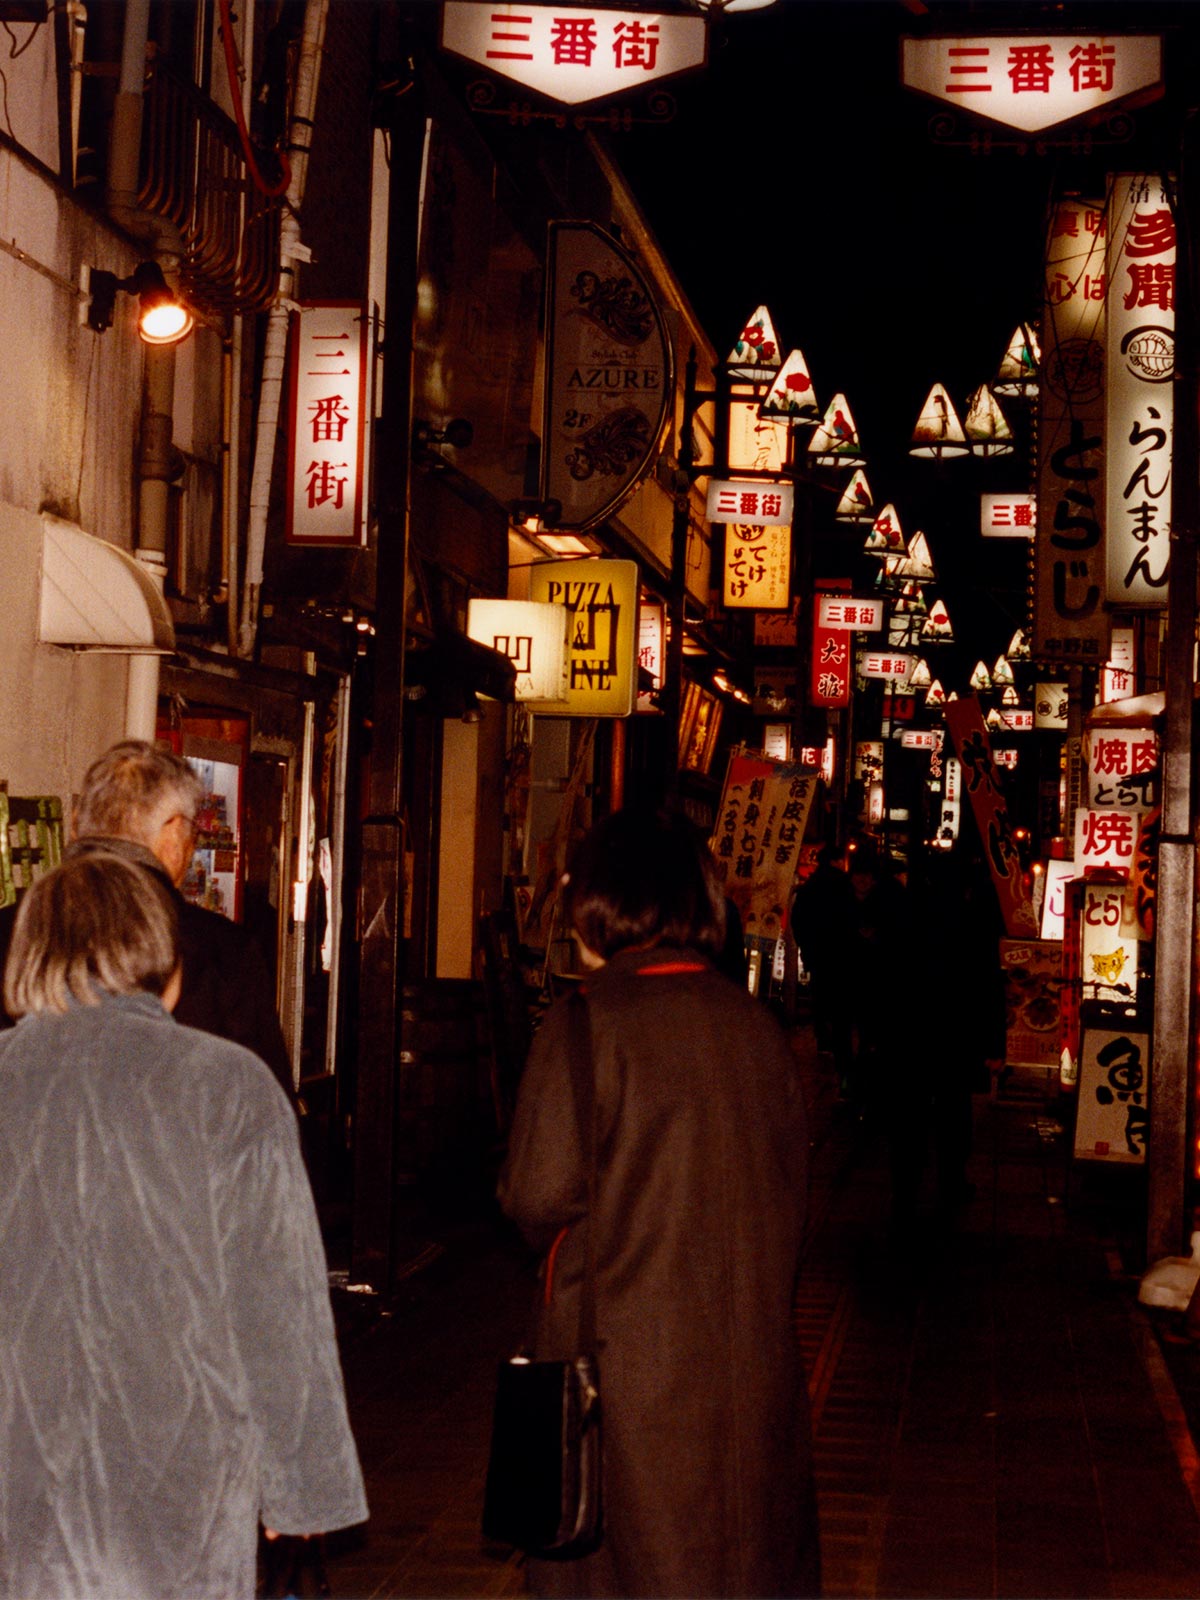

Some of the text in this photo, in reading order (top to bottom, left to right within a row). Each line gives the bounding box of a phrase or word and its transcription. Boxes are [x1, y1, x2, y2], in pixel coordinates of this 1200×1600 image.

[485, 13, 660, 71] 三番街
[945, 42, 1116, 94] 三番街
[567, 369, 660, 389] AZURE
[305, 332, 351, 510] 三番街
[564, 409, 592, 428] 2F
[717, 490, 782, 517] 三番街
[1123, 406, 1171, 589] らんまん
[992, 504, 1037, 526] 三番
[1050, 420, 1102, 621] とらじ
[547, 581, 620, 612] PIZZA
[826, 605, 875, 625] 三番街
[573, 620, 587, 650] &
[569, 659, 612, 691] INE
[867, 657, 907, 675] 三番街
[1002, 714, 1034, 728] 三番街
[905, 735, 933, 747] 三番街
[1093, 737, 1157, 776] 焼肉
